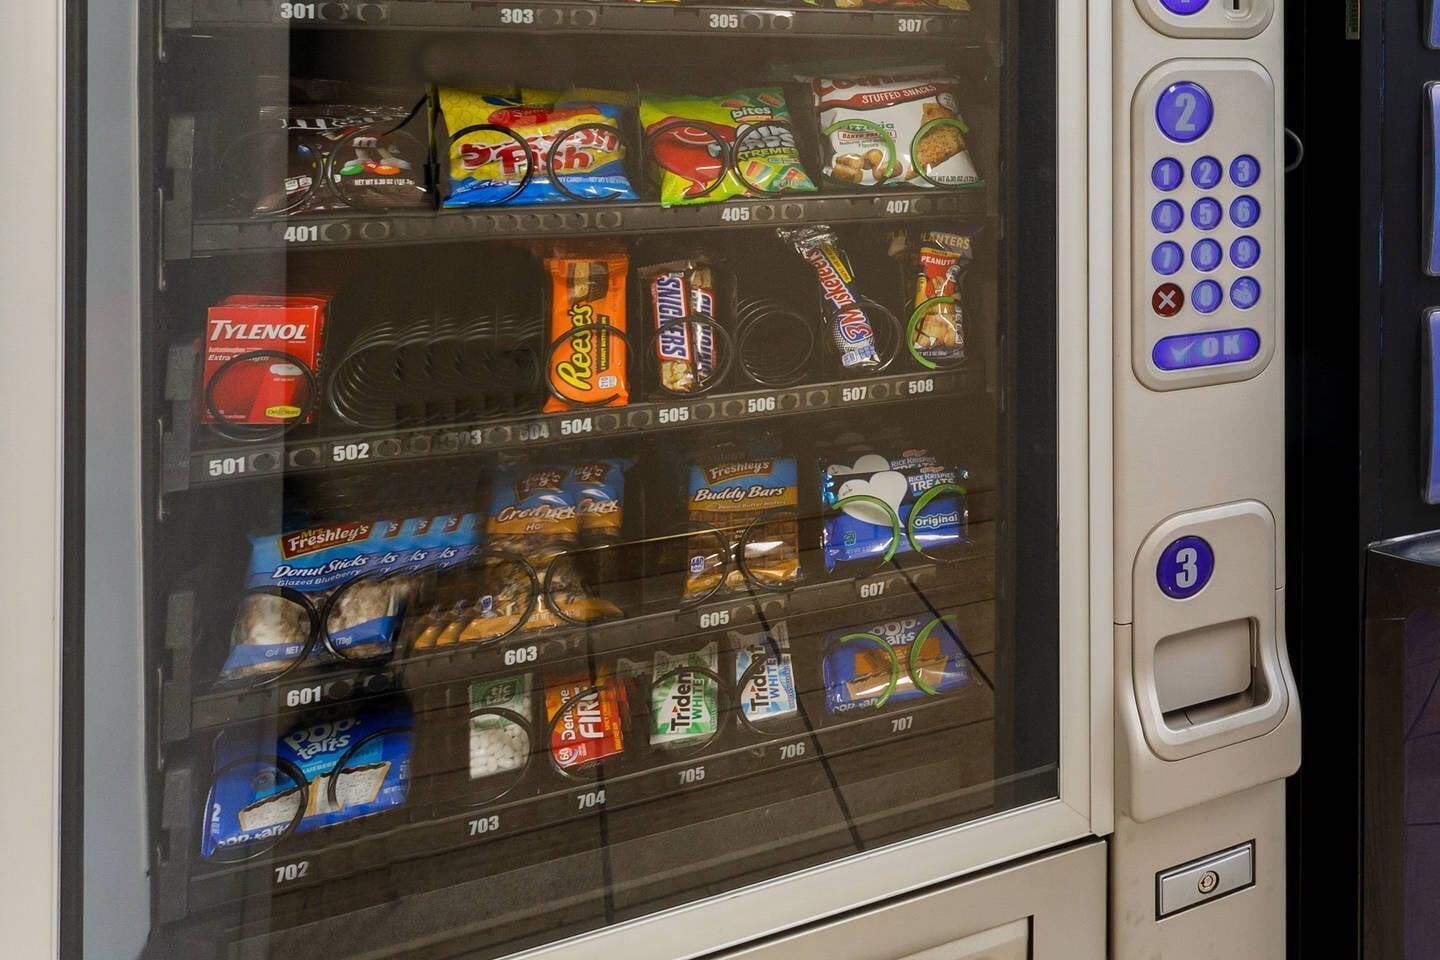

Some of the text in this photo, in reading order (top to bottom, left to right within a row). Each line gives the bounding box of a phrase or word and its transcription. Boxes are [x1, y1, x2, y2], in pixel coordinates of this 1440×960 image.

[280, 3, 314, 19] 301
[501, 9, 534, 24] 303
[709, 14, 738, 28] 305
[898, 19, 921, 33] 307
[861, 89, 901, 104] STUFFED
[903, 84, 937, 98] SNACKS
[732, 105, 772, 118] bites
[1175, 92, 1197, 131] 2
[499, 144, 597, 175] Fish
[1160, 163, 1171, 185] 1
[1200, 161, 1211, 184] 2
[1237, 160, 1250, 182] 3
[722, 208, 750, 222] 405
[886, 201, 909, 214] 407
[1200, 203, 1212, 225] 5
[1237, 200, 1250, 223] 6
[284, 226, 318, 242] 401
[1161, 246, 1172, 269] 7
[1237, 240, 1250, 262] 9
[1201, 284, 1212, 307] 0
[658, 276, 690, 358] SNICKERS
[210, 320, 309, 341] TYLENOL
[556, 304, 594, 390] Reese's
[1201, 334, 1242, 358] OK
[842, 386, 867, 401] 507
[908, 379, 934, 393] 508
[748, 397, 775, 412] 506
[659, 407, 689, 423] 505
[561, 419, 592, 434] 504
[333, 443, 369, 461] 502
[209, 457, 245, 475] 501
[709, 460, 770, 480] Freshley's
[891, 460, 905, 468] RICE
[908, 472, 955, 484] RICE KRISPIES
[694, 486, 785, 502] Buddy Bars
[915, 514, 959, 528] Original
[288, 524, 369, 552] Freshley's
[272, 555, 369, 579] Donut Sticks
[1175, 547, 1198, 589] 3
[277, 569, 361, 587] Glazed Blueberry
[860, 582, 885, 598] 607
[700, 611, 729, 627] 605
[504, 647, 537, 665] 603
[749, 644, 768, 713] Trident
[769, 656, 778, 700] WHITE
[286, 687, 322, 706] 601
[670, 664, 692, 732] Trident
[692, 677, 704, 727] WHITE
[891, 717, 913, 732] 707
[297, 734, 351, 760] tarts
[559, 747, 574, 761] 60
[780, 743, 805, 760] 706
[678, 767, 705, 784] 705
[577, 790, 607, 809] 704
[213, 803, 222, 822] 2
[469, 816, 500, 835] 703
[275, 863, 309, 883] 702
